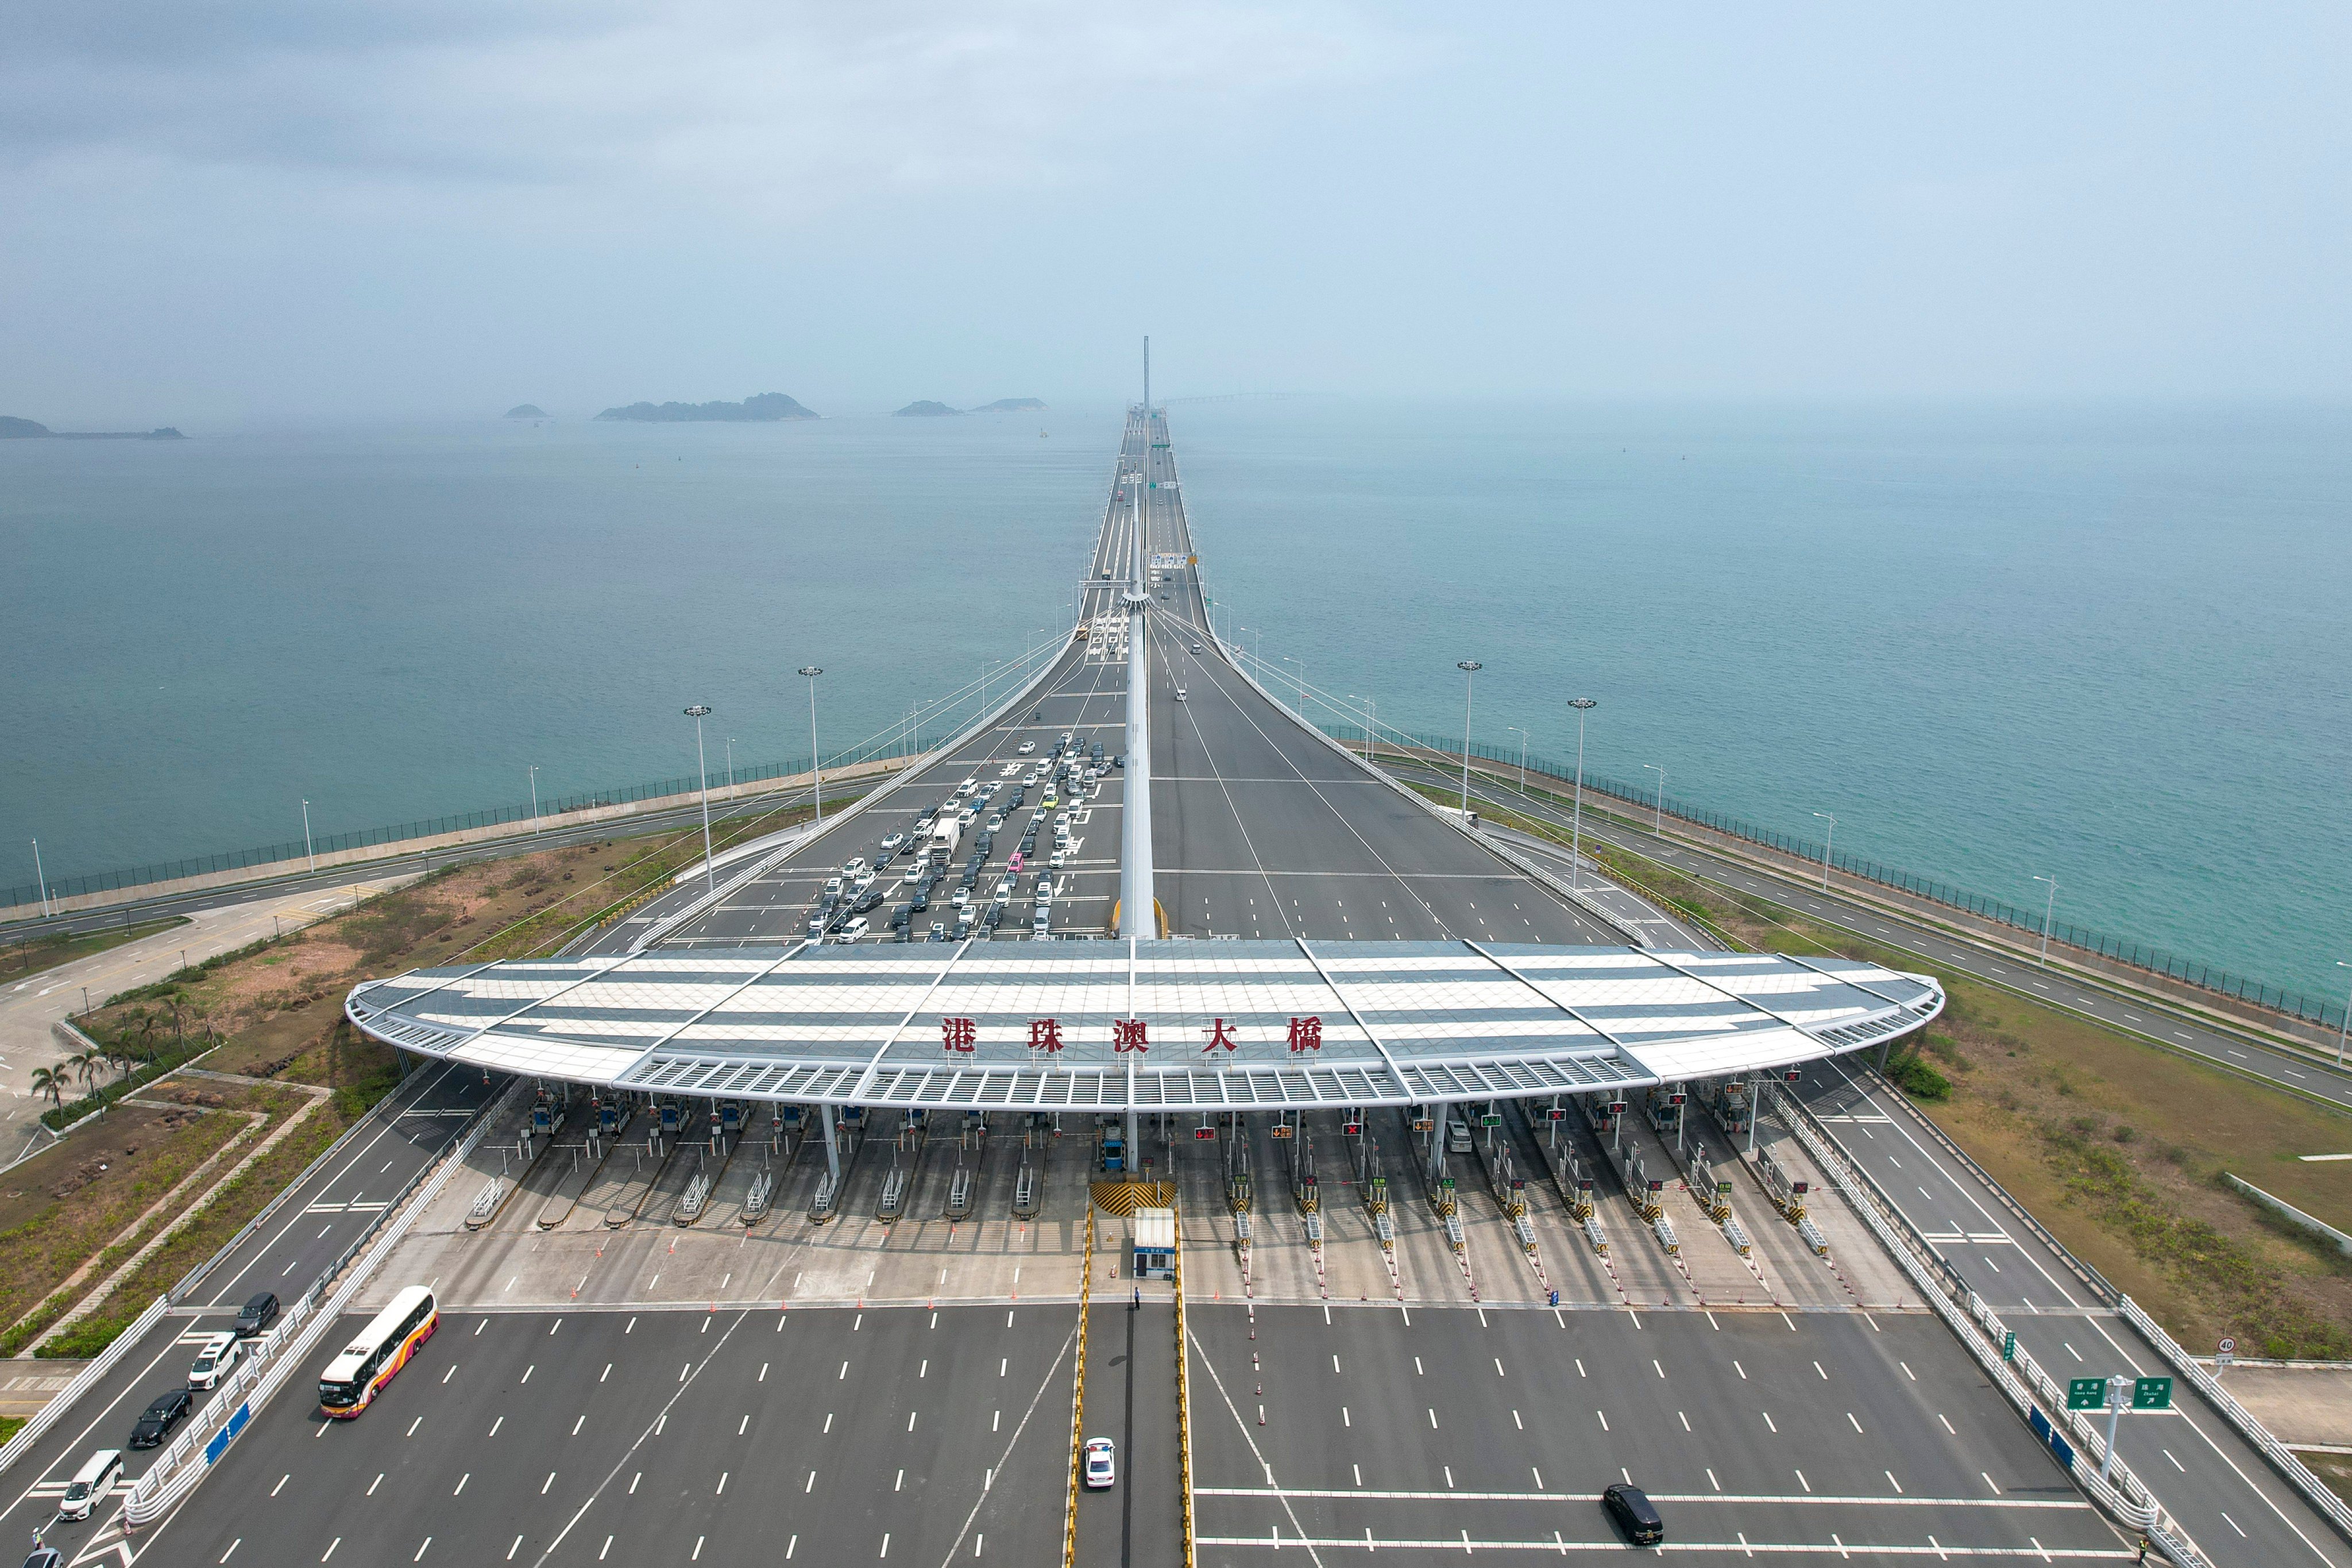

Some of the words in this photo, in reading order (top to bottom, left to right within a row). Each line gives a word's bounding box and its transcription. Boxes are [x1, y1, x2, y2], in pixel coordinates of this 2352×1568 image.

[941, 1017, 1322, 1053] 港珠澳大橋
[2221, 1341, 2232, 1349] 40
